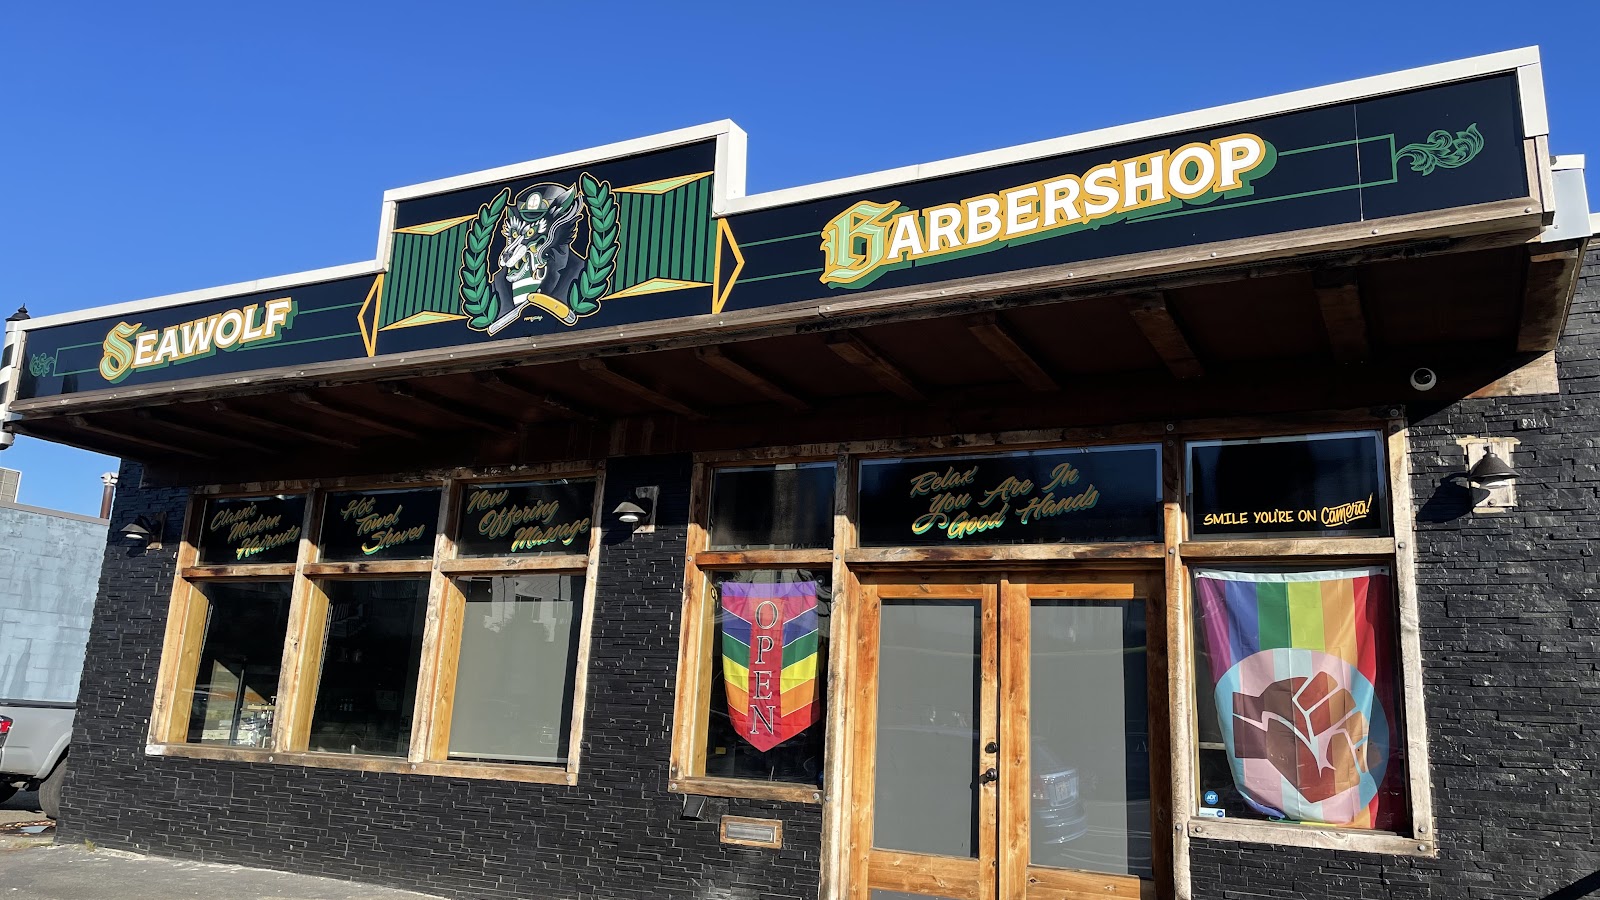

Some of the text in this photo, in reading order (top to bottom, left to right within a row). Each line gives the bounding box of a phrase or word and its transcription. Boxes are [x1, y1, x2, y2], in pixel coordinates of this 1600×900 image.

[819, 132, 1275, 289] BARBERSHOP
[99, 297, 297, 382] SEAWOLF
[910, 466, 979, 498] Relax
[977, 476, 1034, 508] Are
[1041, 462, 1080, 492] In
[210, 501, 257, 532] Classic
[341, 496, 376, 520] Hot
[467, 489, 510, 514] Now
[478, 499, 560, 539] Offering
[946, 484, 1101, 540] Good Hands
[1203, 492, 1374, 528] SMILE YOU'RE ON Camera!
[226, 513, 281, 544] Modern
[355, 504, 403, 537] Towel
[510, 517, 590, 552] Massage
[236, 525, 301, 560] Haircuts
[362, 522, 426, 556] Shaves
[749, 600, 779, 736] OPEN
